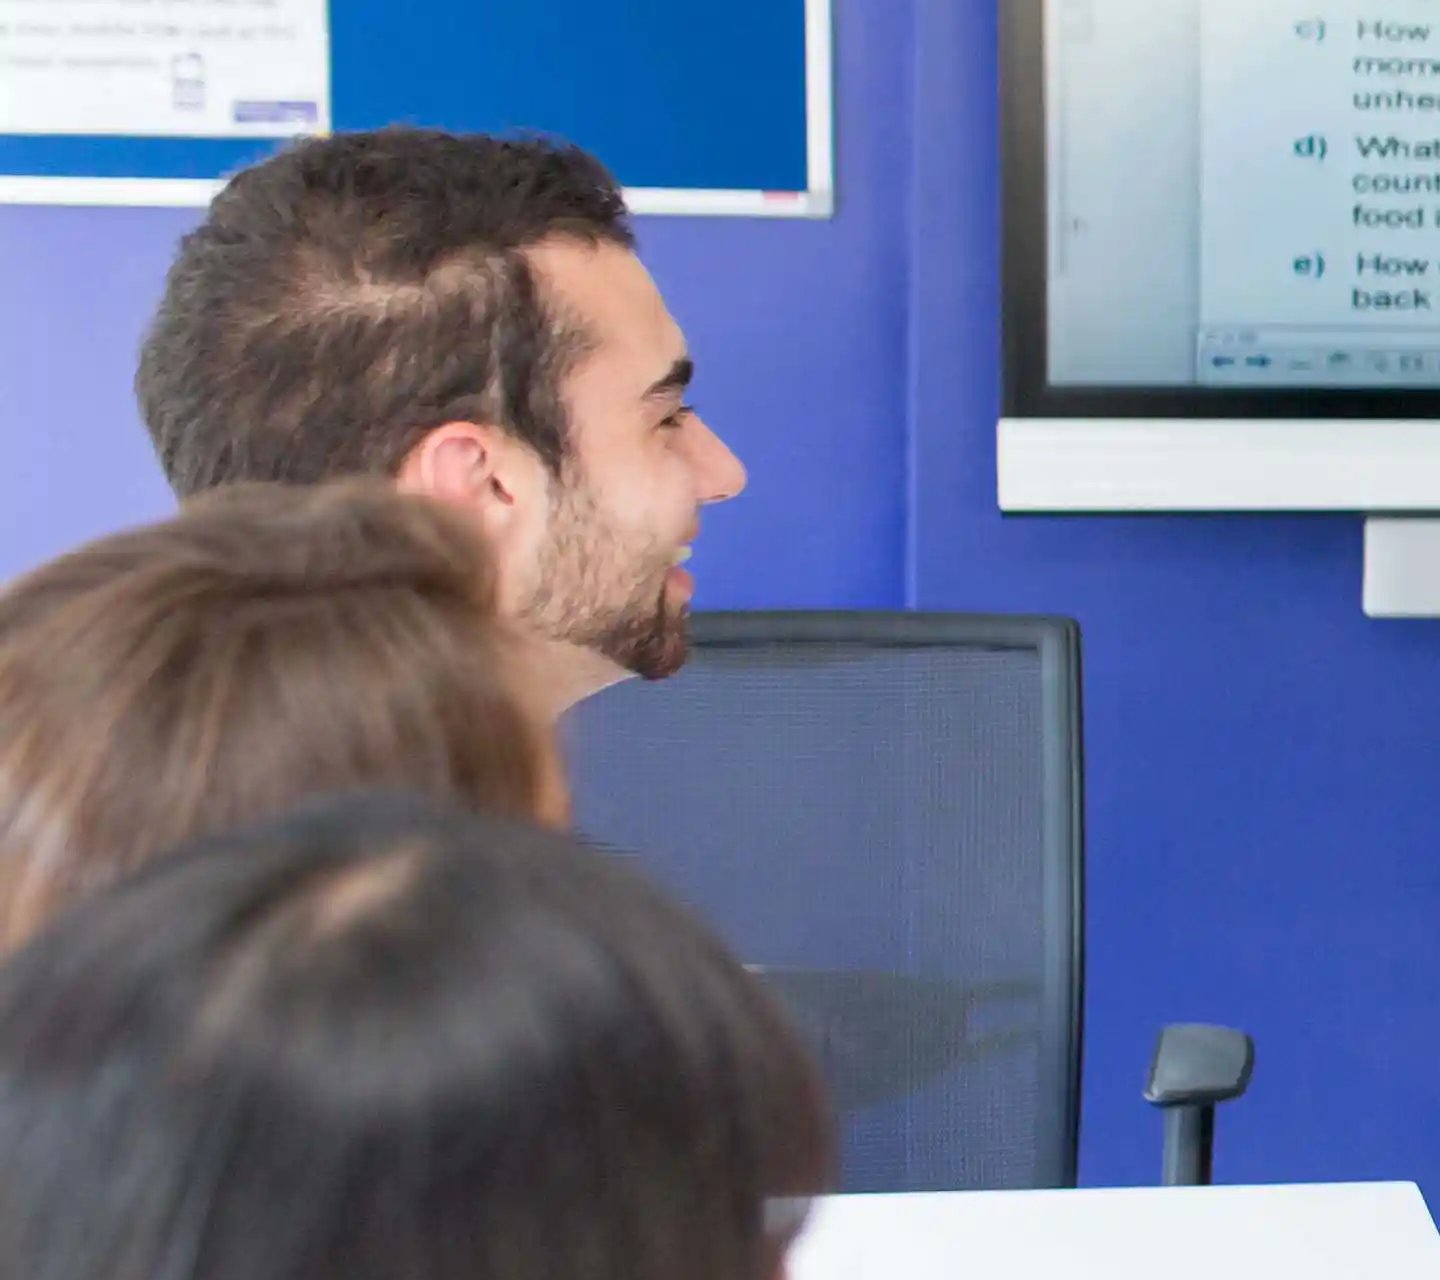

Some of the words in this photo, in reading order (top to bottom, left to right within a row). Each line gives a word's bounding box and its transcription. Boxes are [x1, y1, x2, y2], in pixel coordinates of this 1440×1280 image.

[1294, 19, 1327, 43] c)
[1355, 19, 1430, 43] How
[1294, 135, 1329, 161] d)
[1352, 205, 1426, 230] food
[1292, 252, 1326, 279] e)
[1355, 251, 1430, 278] How
[1352, 287, 1431, 312] back
